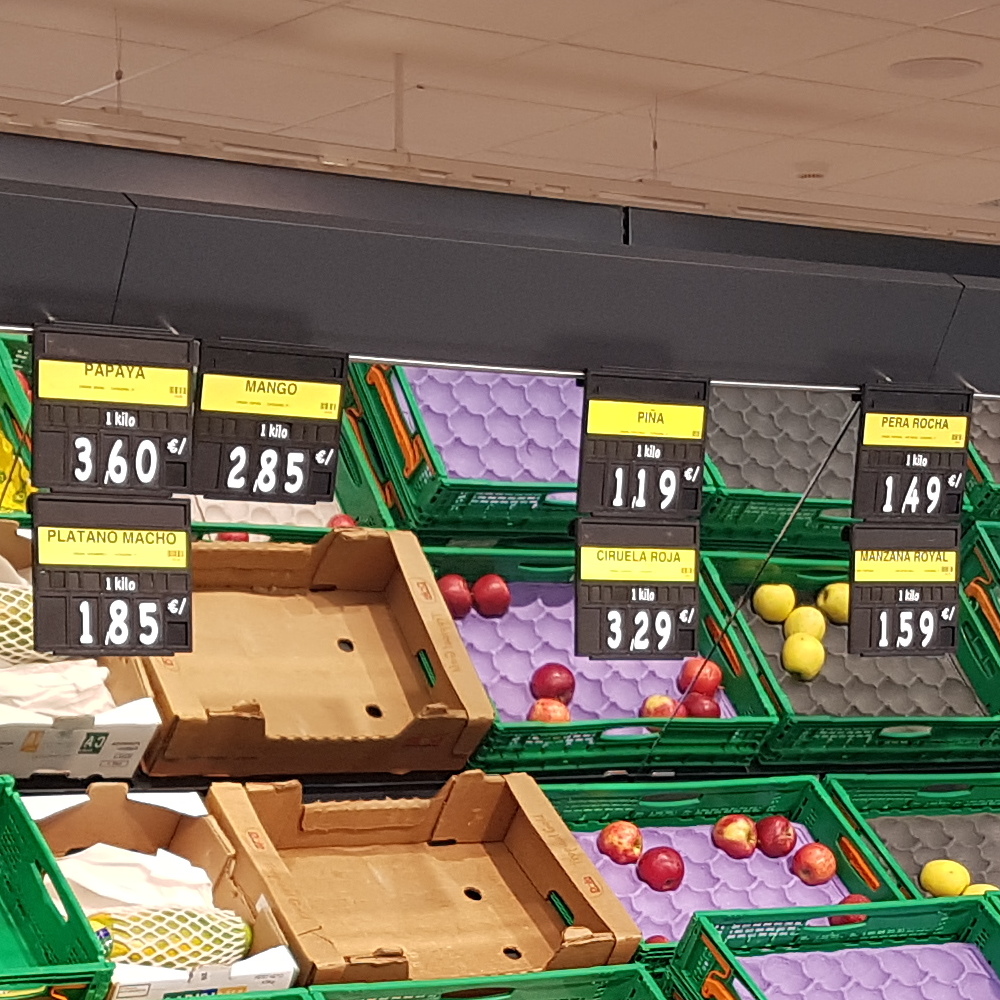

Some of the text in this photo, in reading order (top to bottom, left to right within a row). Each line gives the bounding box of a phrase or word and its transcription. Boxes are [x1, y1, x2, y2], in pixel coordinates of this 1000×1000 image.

[84, 362, 146, 379] PAPAYA
[245, 380, 298, 395] MANGO
[106, 411, 136, 427] 1 kilo
[637, 409, 665, 424] PIÑA
[881, 416, 949, 429] PERA ROCHA
[260, 423, 288, 439] 1 kilo
[636, 444, 661, 459] 1 kilo
[906, 453, 928, 467] 1 kilo
[47, 529, 177, 545] PLATANO MACHO
[596, 550, 681, 562] CIRUELA ROJA
[860, 550, 949, 563] MANZANA ROYAL
[105, 576, 136, 591] 1 kilo
[631, 587, 655, 601] 1 kilo
[898, 588, 920, 602] 1 kilo
